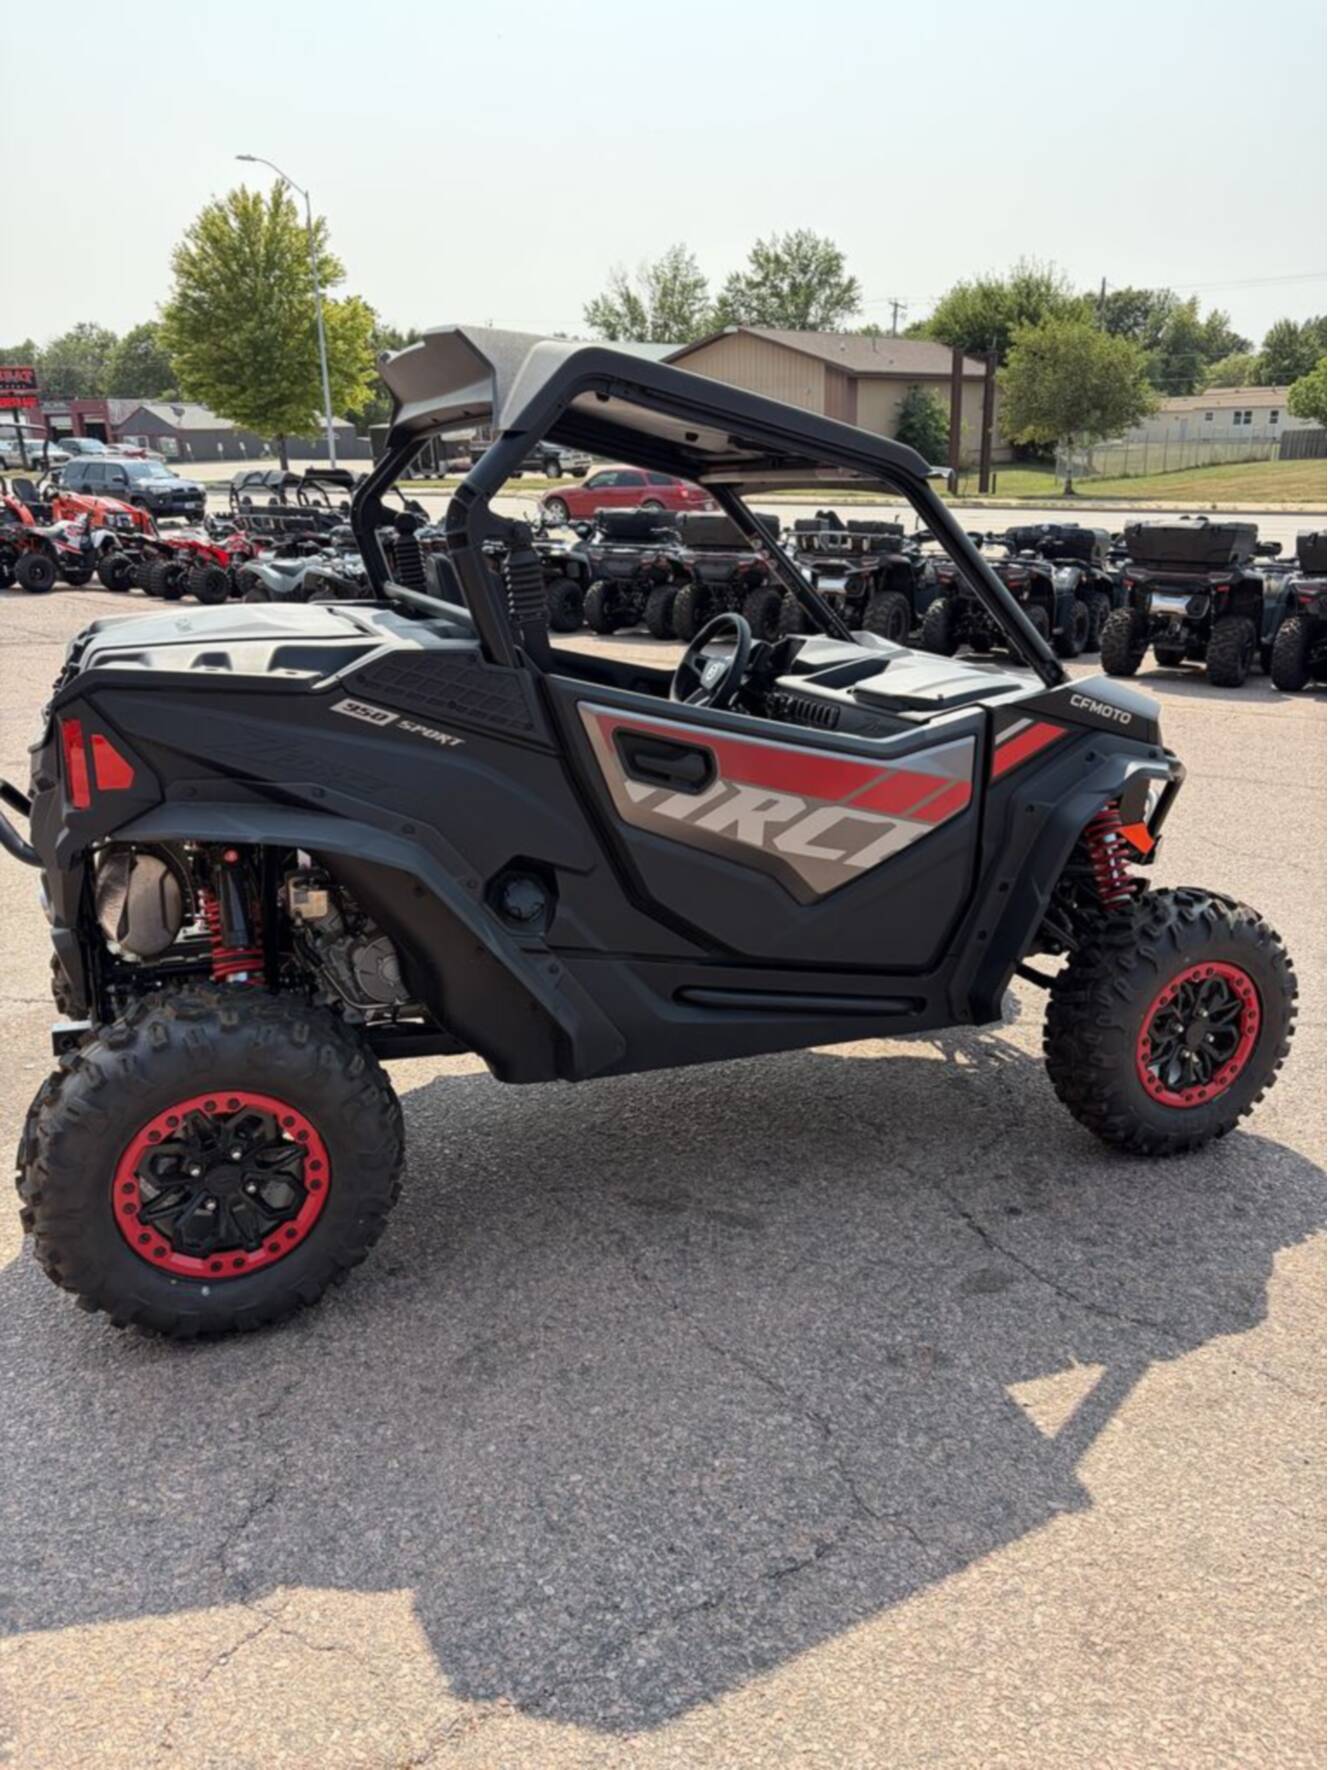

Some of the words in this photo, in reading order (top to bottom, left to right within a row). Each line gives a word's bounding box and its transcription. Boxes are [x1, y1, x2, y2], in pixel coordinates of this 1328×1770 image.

[341, 702, 390, 722] 950
[397, 719, 466, 746] SPORT
[1069, 694, 1132, 725] CFMOTO
